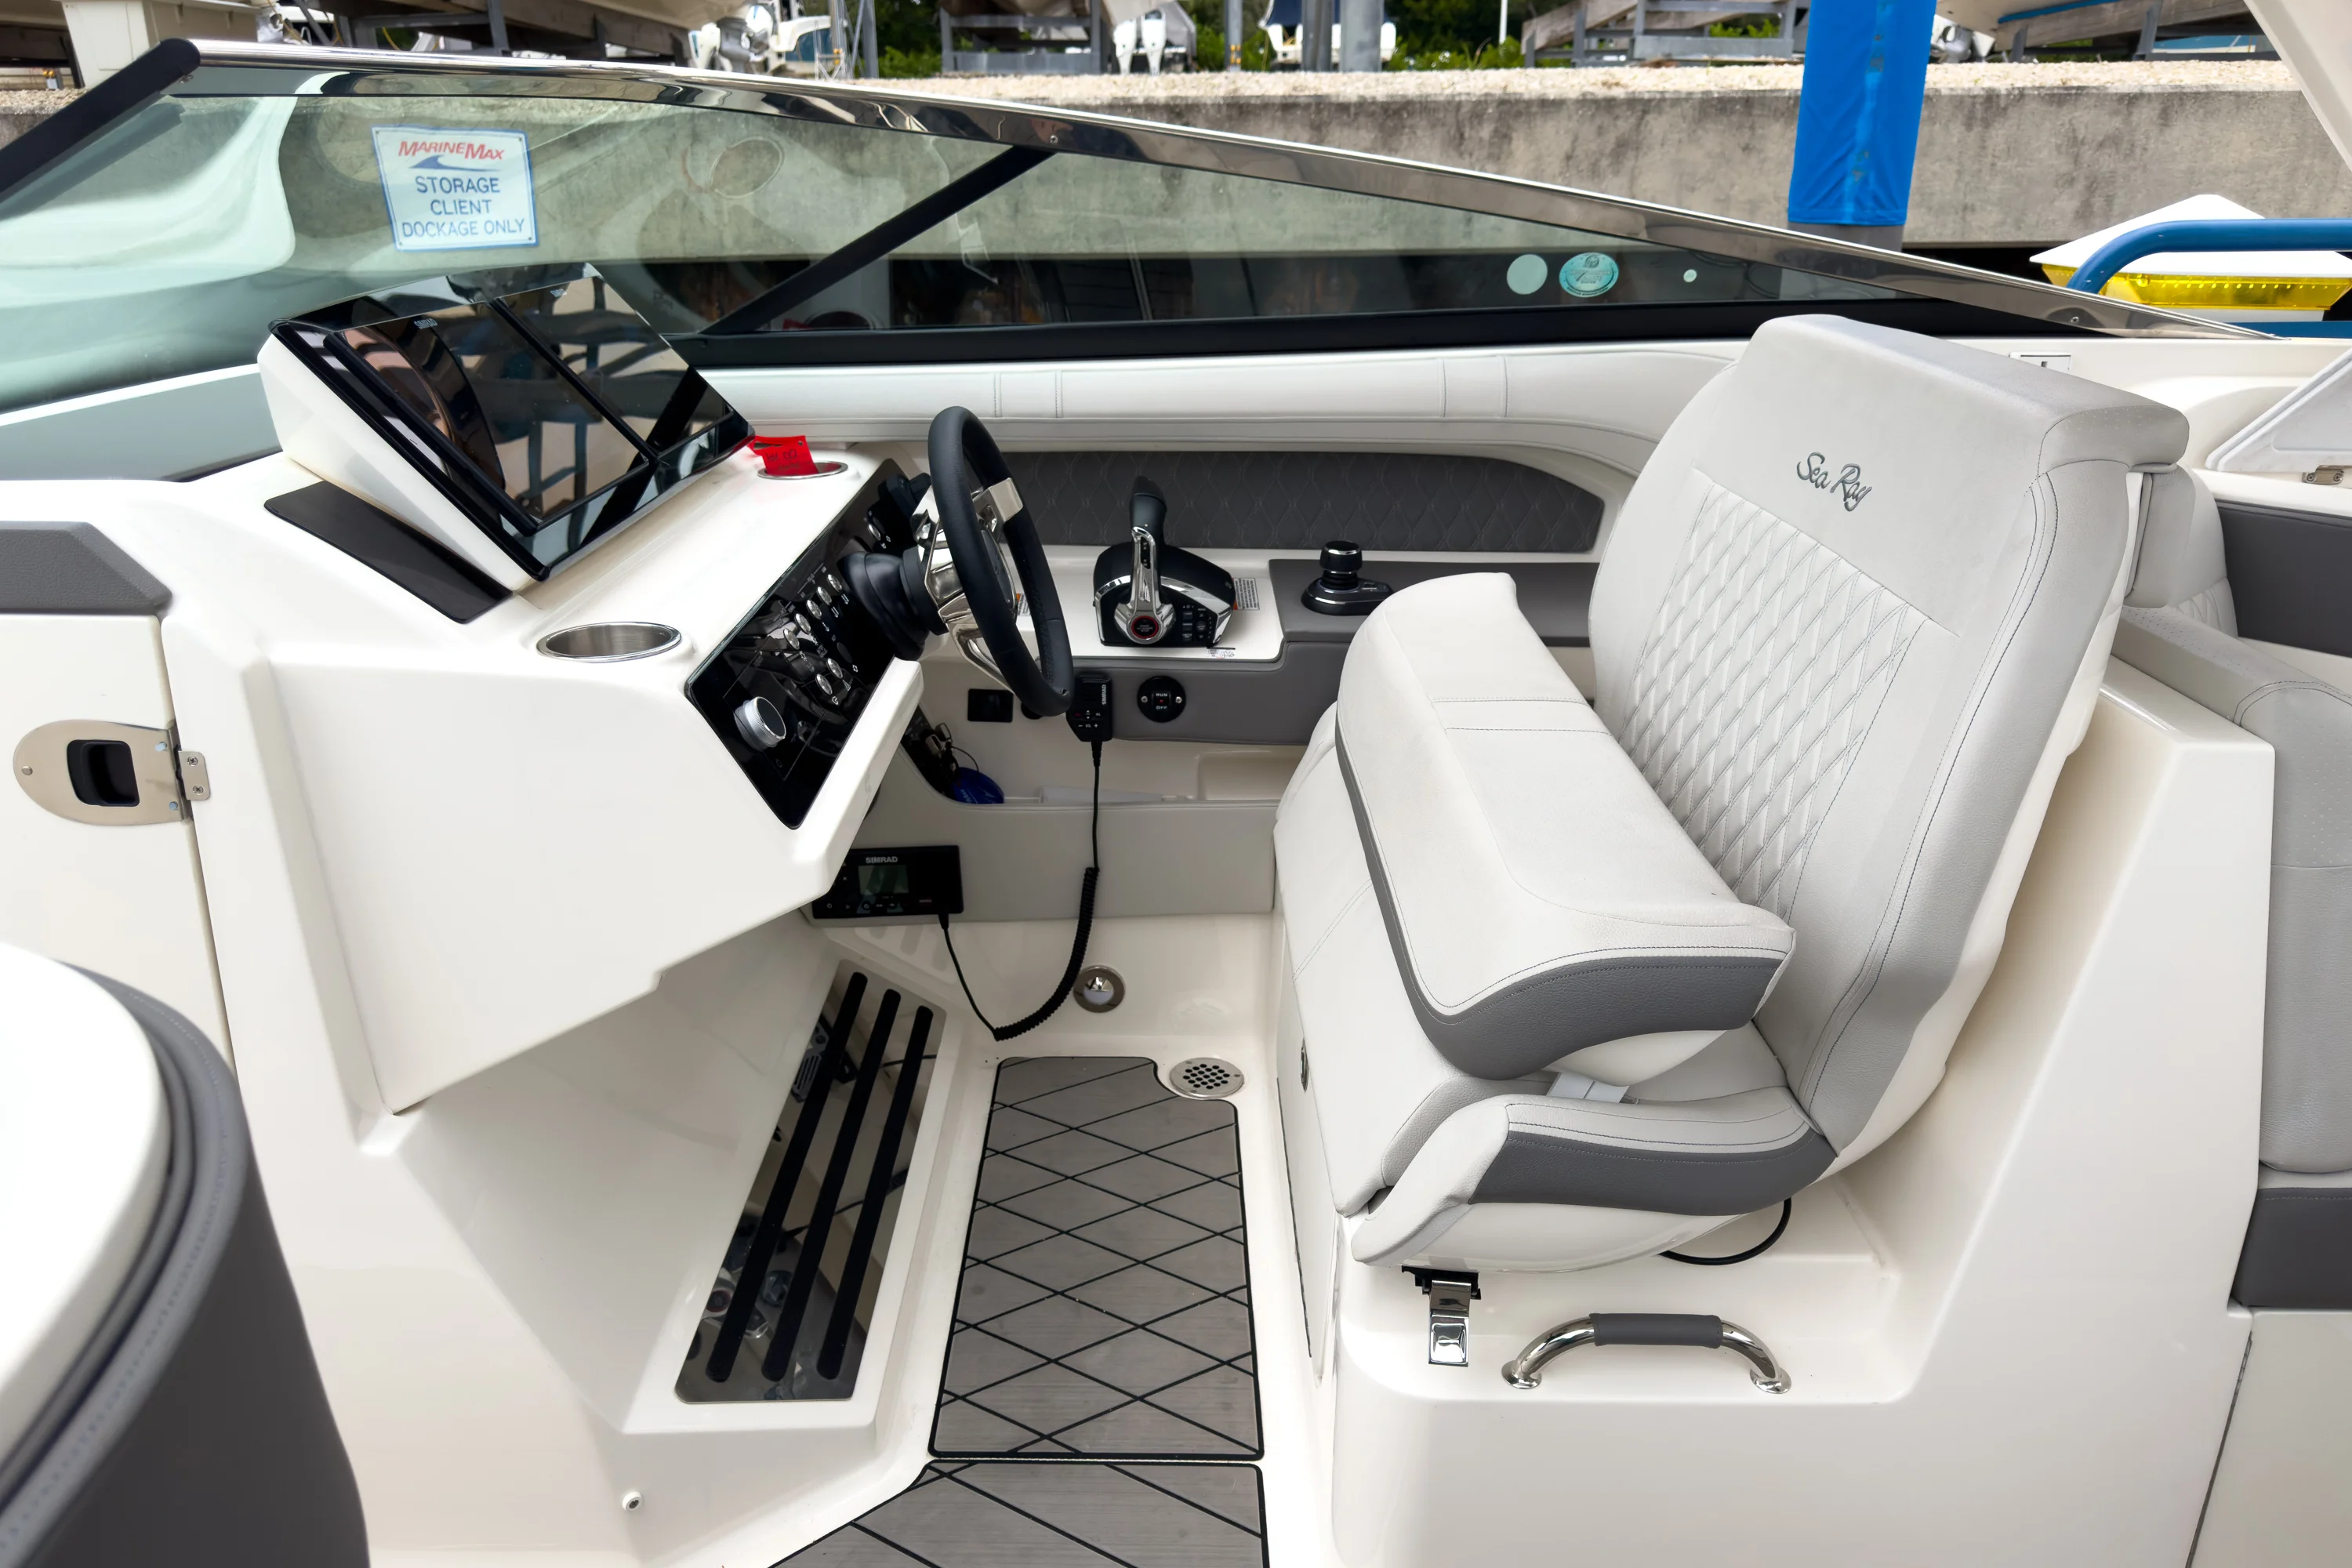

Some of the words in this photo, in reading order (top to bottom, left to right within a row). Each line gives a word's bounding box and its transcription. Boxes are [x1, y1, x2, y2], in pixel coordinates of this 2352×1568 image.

[416, 176, 500, 194] STORAGE
[430, 199, 492, 216] CLIENT
[402, 221, 478, 238] DOCKAGE
[484, 218, 524, 235] ONLY
[1796, 452, 1831, 489] Sea
[1830, 463, 1872, 512] Ray
